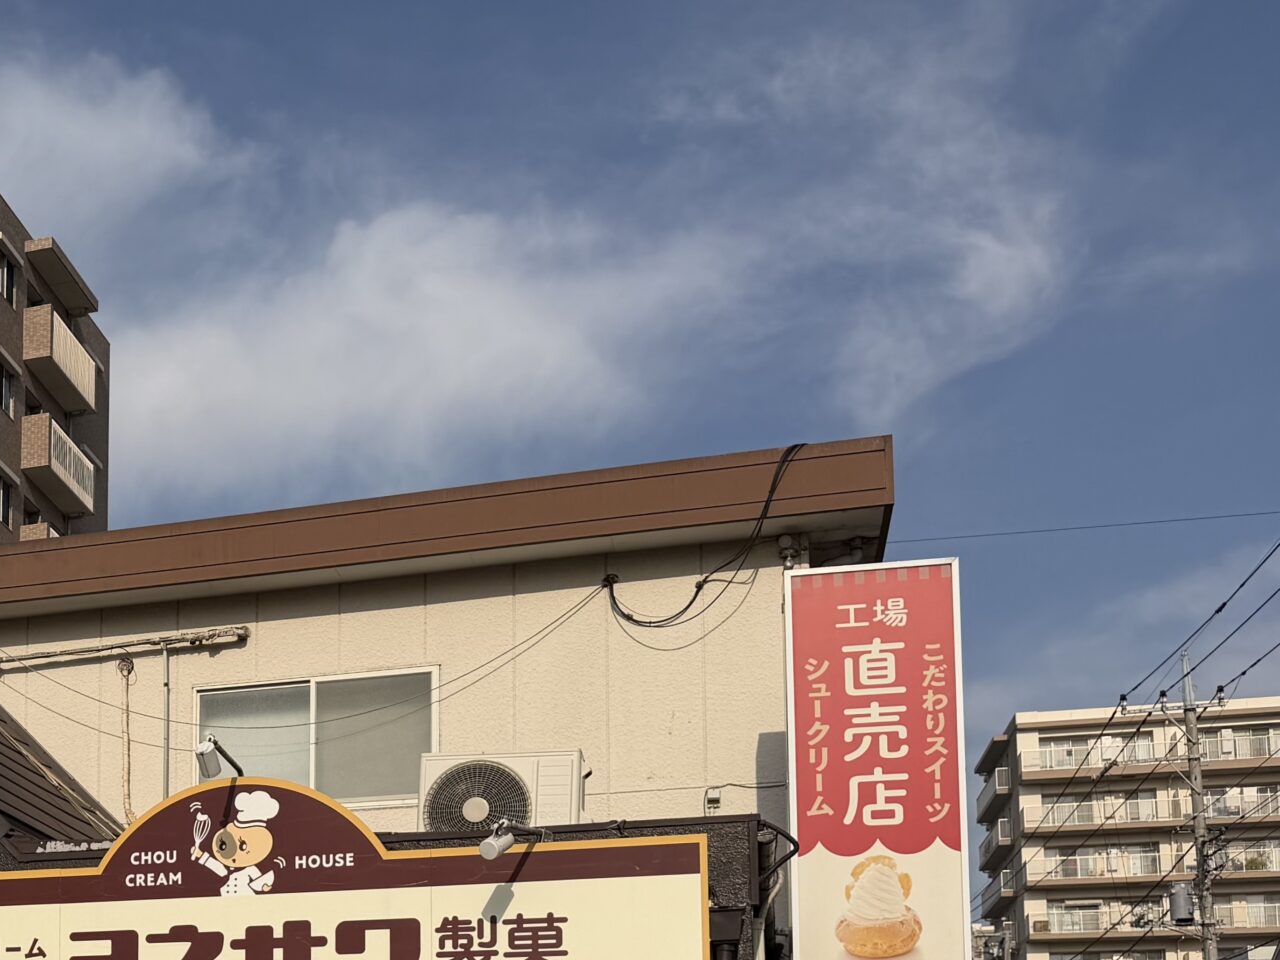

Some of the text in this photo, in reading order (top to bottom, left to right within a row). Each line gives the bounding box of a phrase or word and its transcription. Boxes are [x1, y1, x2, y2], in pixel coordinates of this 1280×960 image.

[835, 597, 908, 628] 工場
[804, 658, 834, 818] シュークリーム
[841, 637, 909, 826] 直売店
[921, 643, 951, 824] こだわりスイーツ
[125, 871, 183, 888] CREAM
[130, 849, 355, 869] CHOU HOUSE
